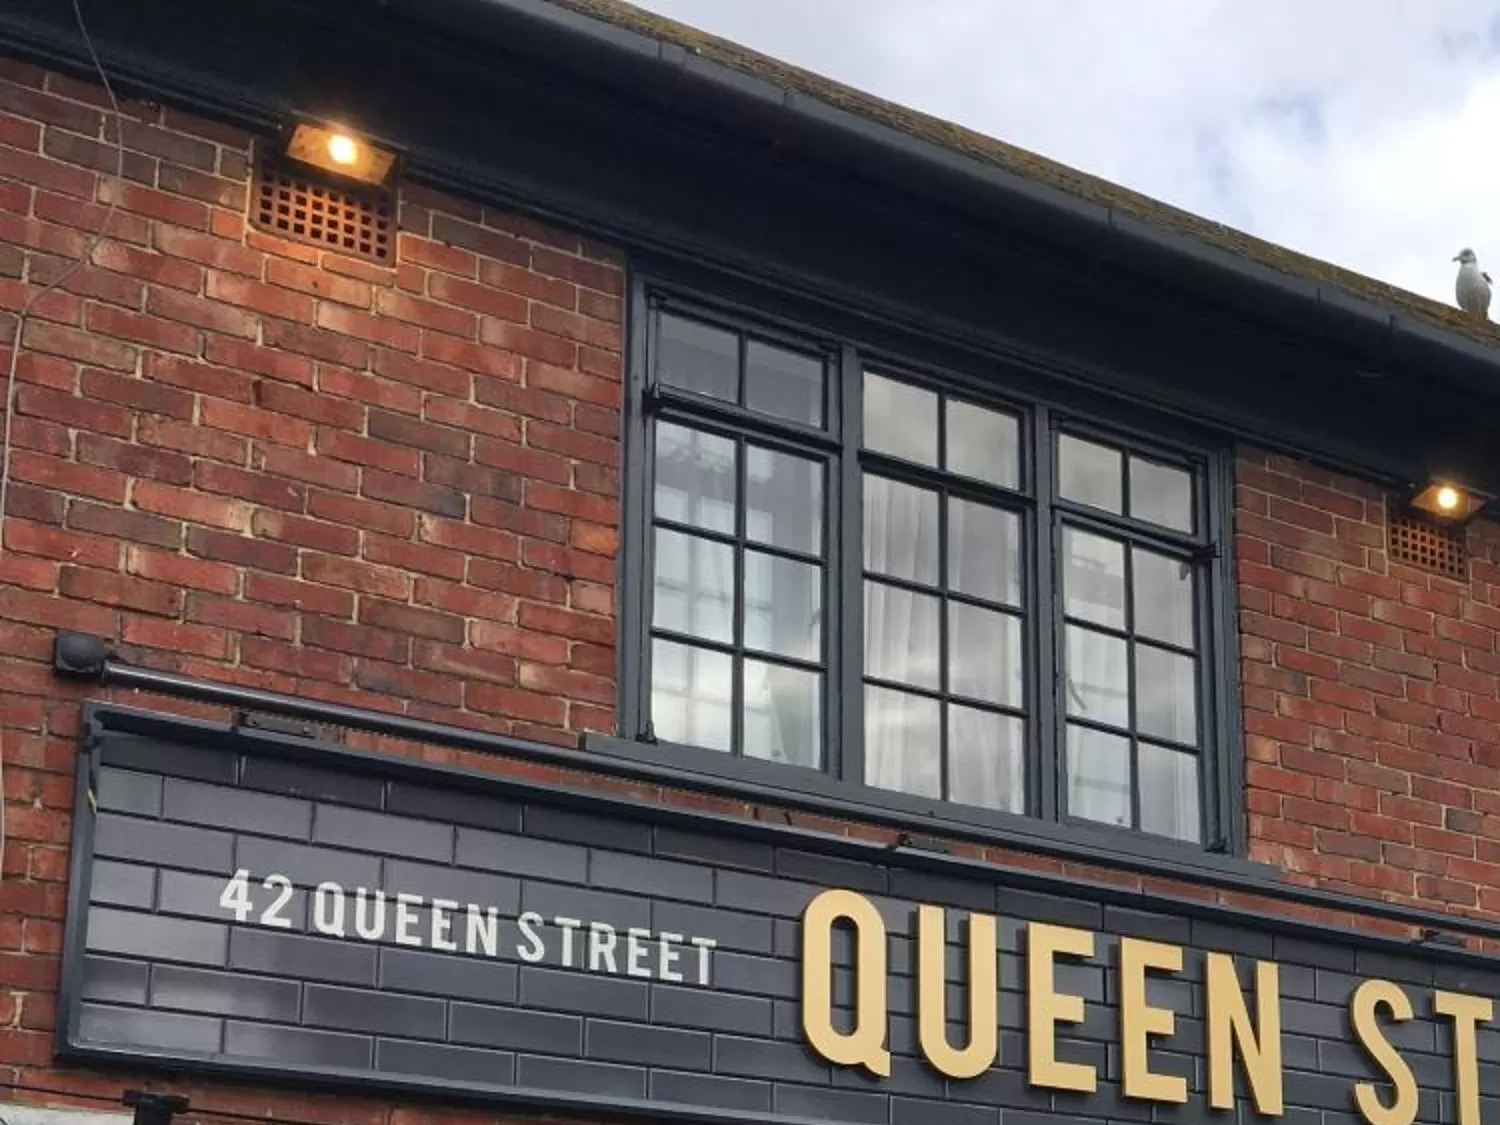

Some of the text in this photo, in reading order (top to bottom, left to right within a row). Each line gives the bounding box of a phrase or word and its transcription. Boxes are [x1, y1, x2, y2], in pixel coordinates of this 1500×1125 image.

[219, 868, 718, 986] 42 QUEEN STREET
[802, 888, 1284, 1117] QUEEN
